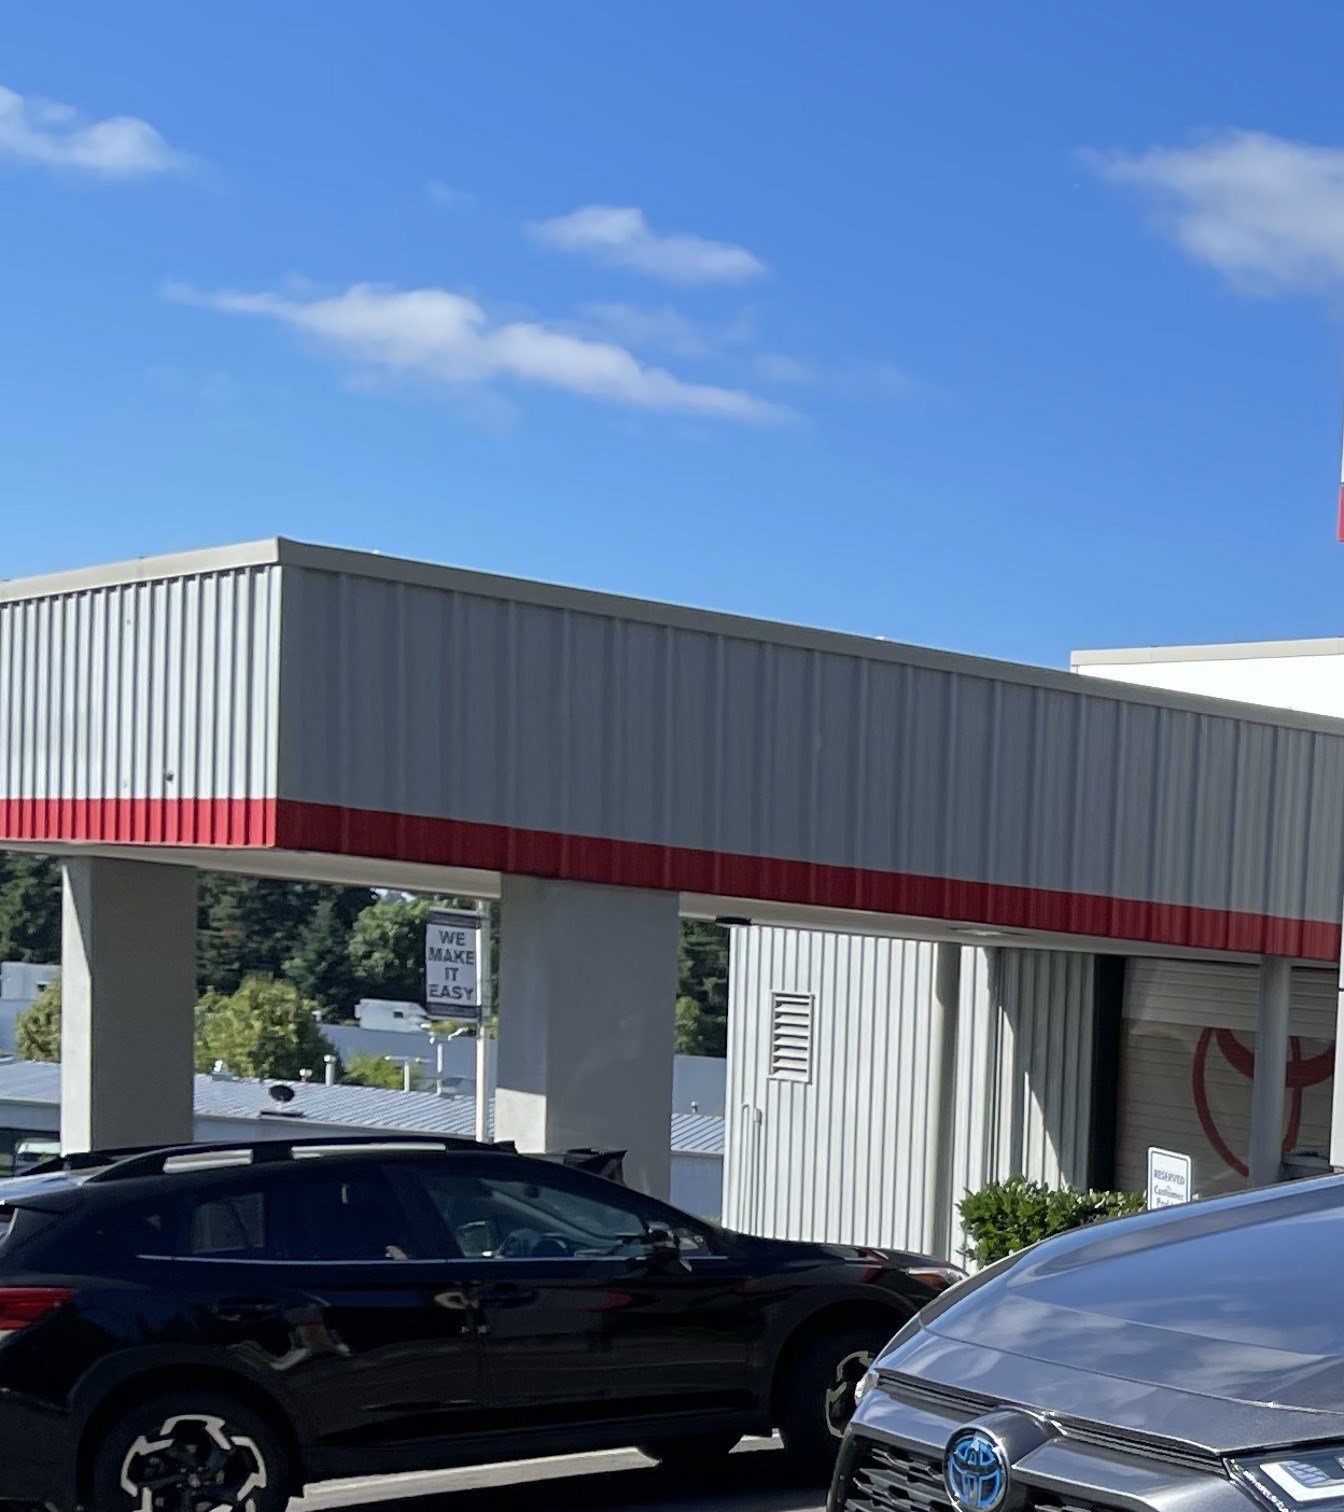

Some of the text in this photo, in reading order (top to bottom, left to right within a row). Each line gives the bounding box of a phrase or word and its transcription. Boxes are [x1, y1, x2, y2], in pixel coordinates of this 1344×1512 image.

[438, 930, 466, 946] WE
[428, 947, 475, 966] MAKE
[444, 967, 459, 982] IT
[429, 984, 474, 1001] EASY
[1154, 1169, 1185, 1186] RESERVED
